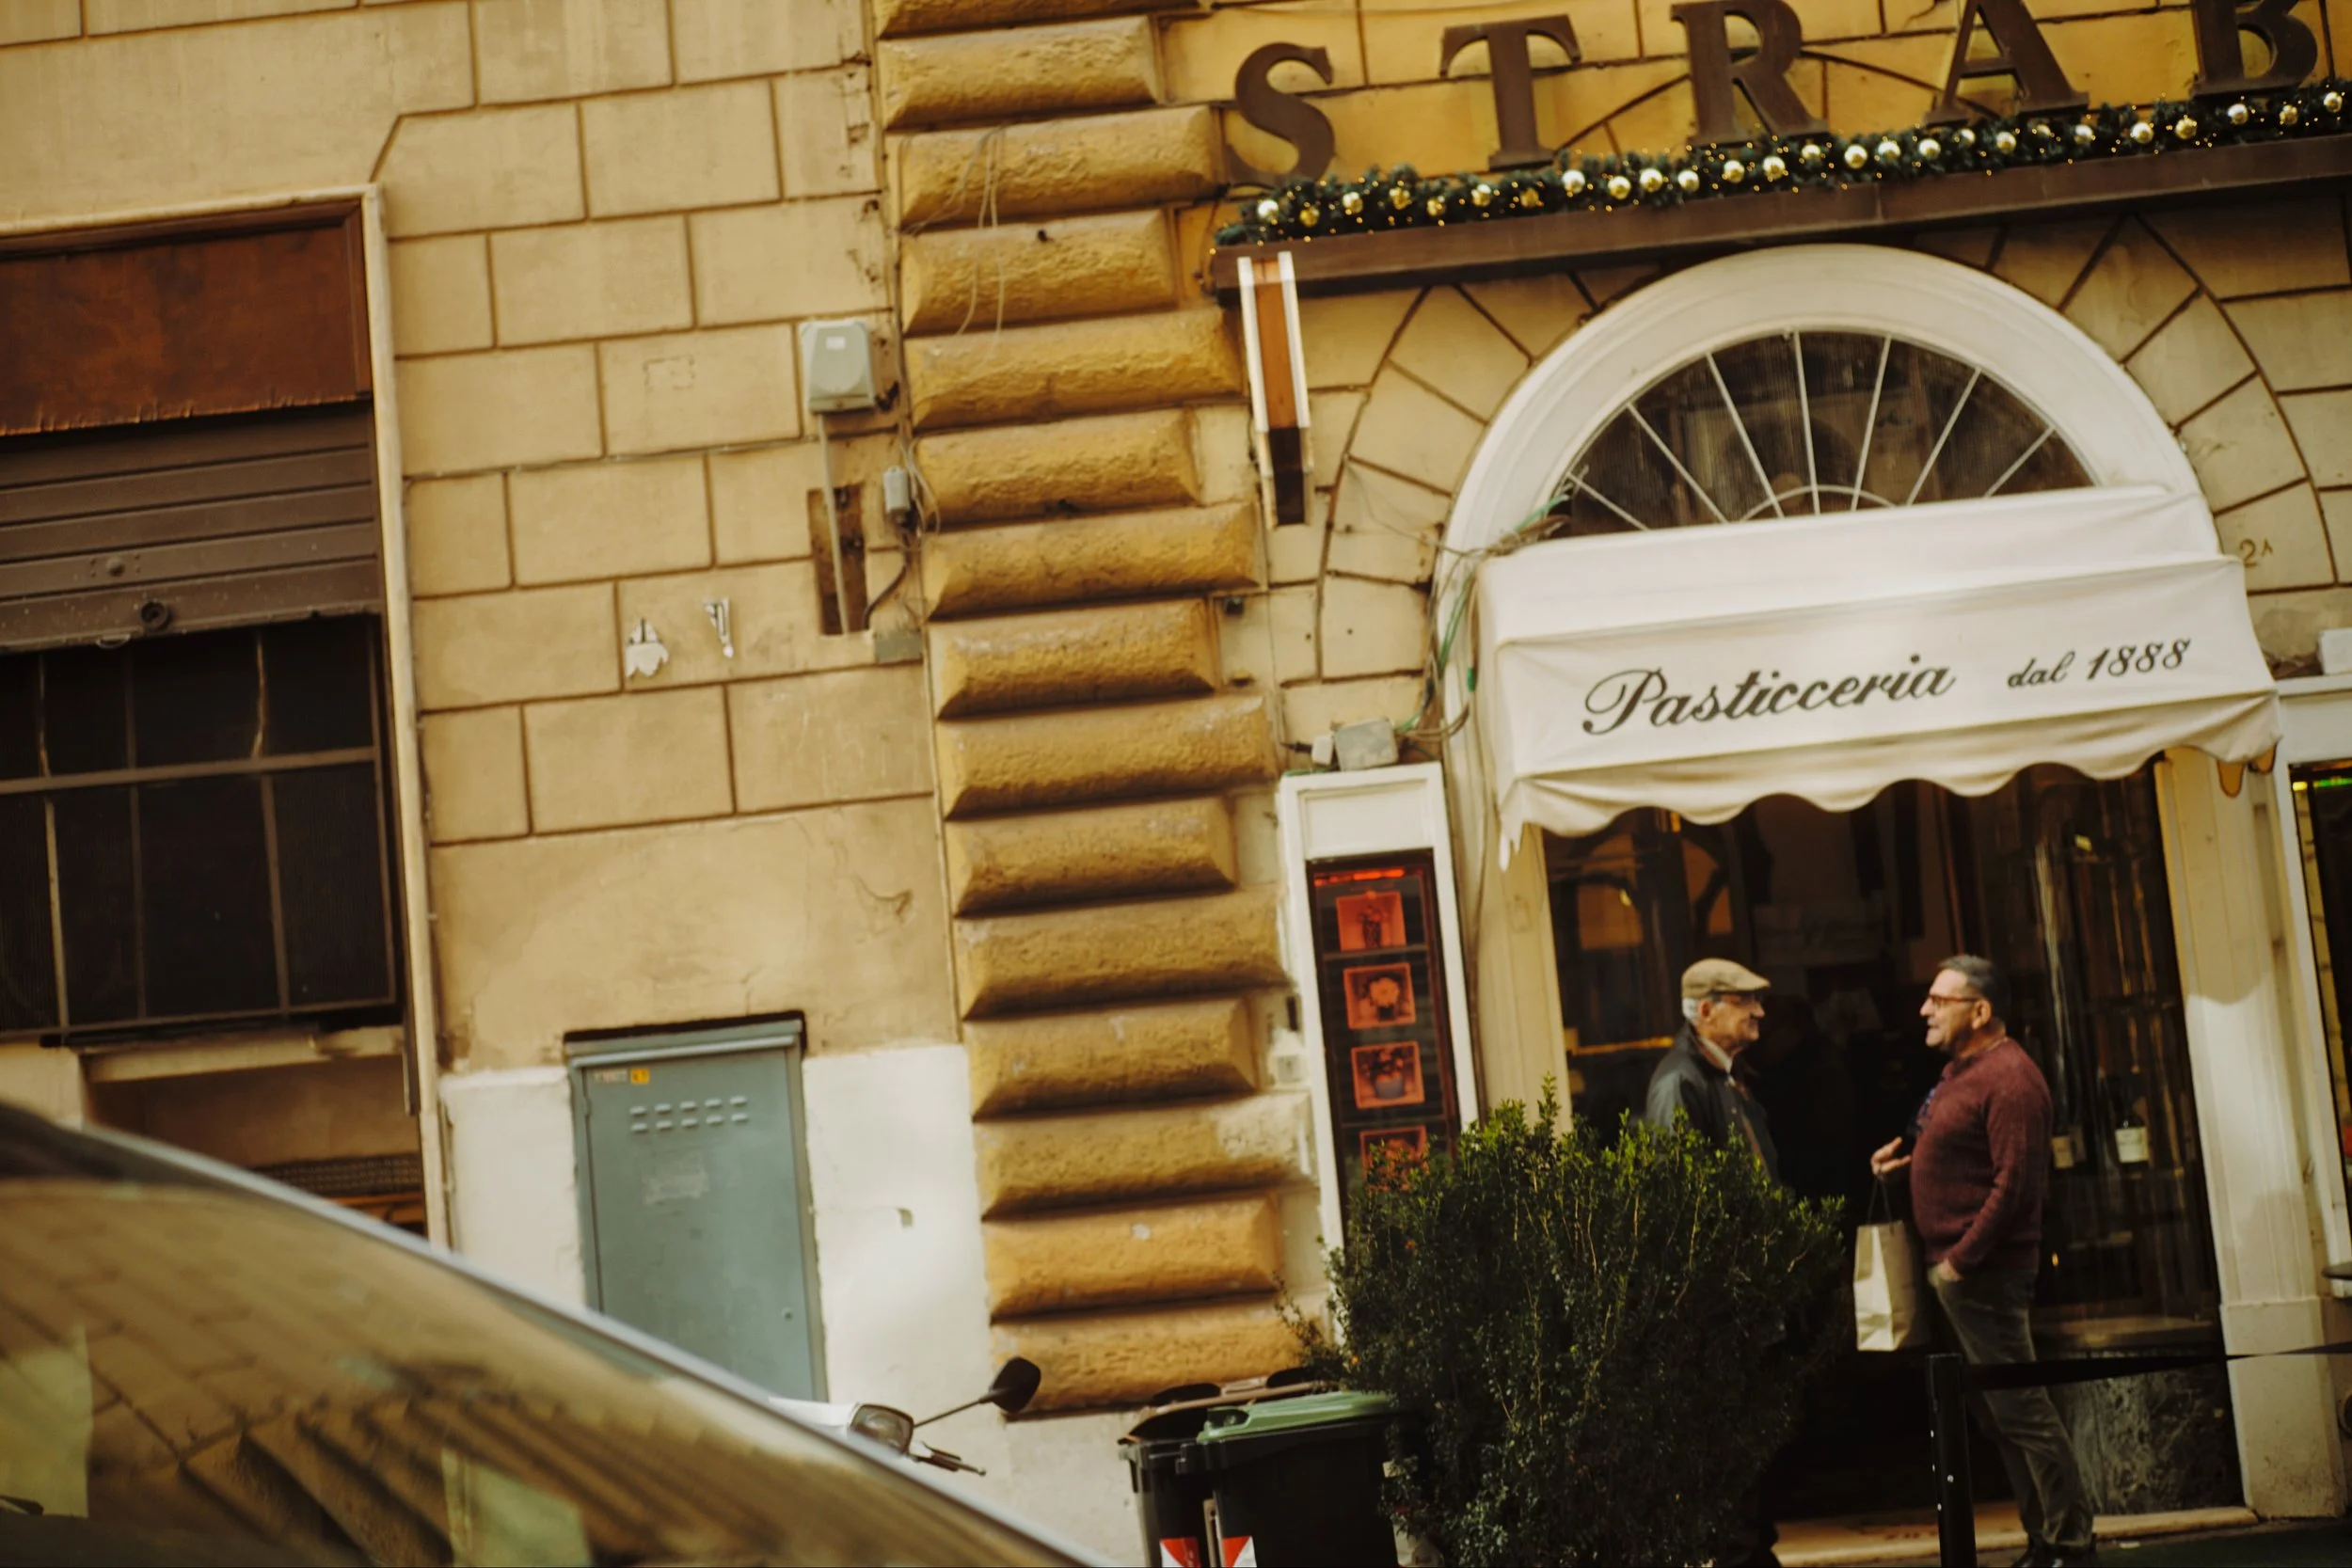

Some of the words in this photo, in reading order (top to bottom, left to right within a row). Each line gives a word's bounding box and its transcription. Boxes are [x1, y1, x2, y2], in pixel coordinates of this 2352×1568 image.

[1581, 653, 1958, 736] Pasticceria
[2007, 650, 2076, 689] dal
[2087, 637, 2192, 681] 1888
